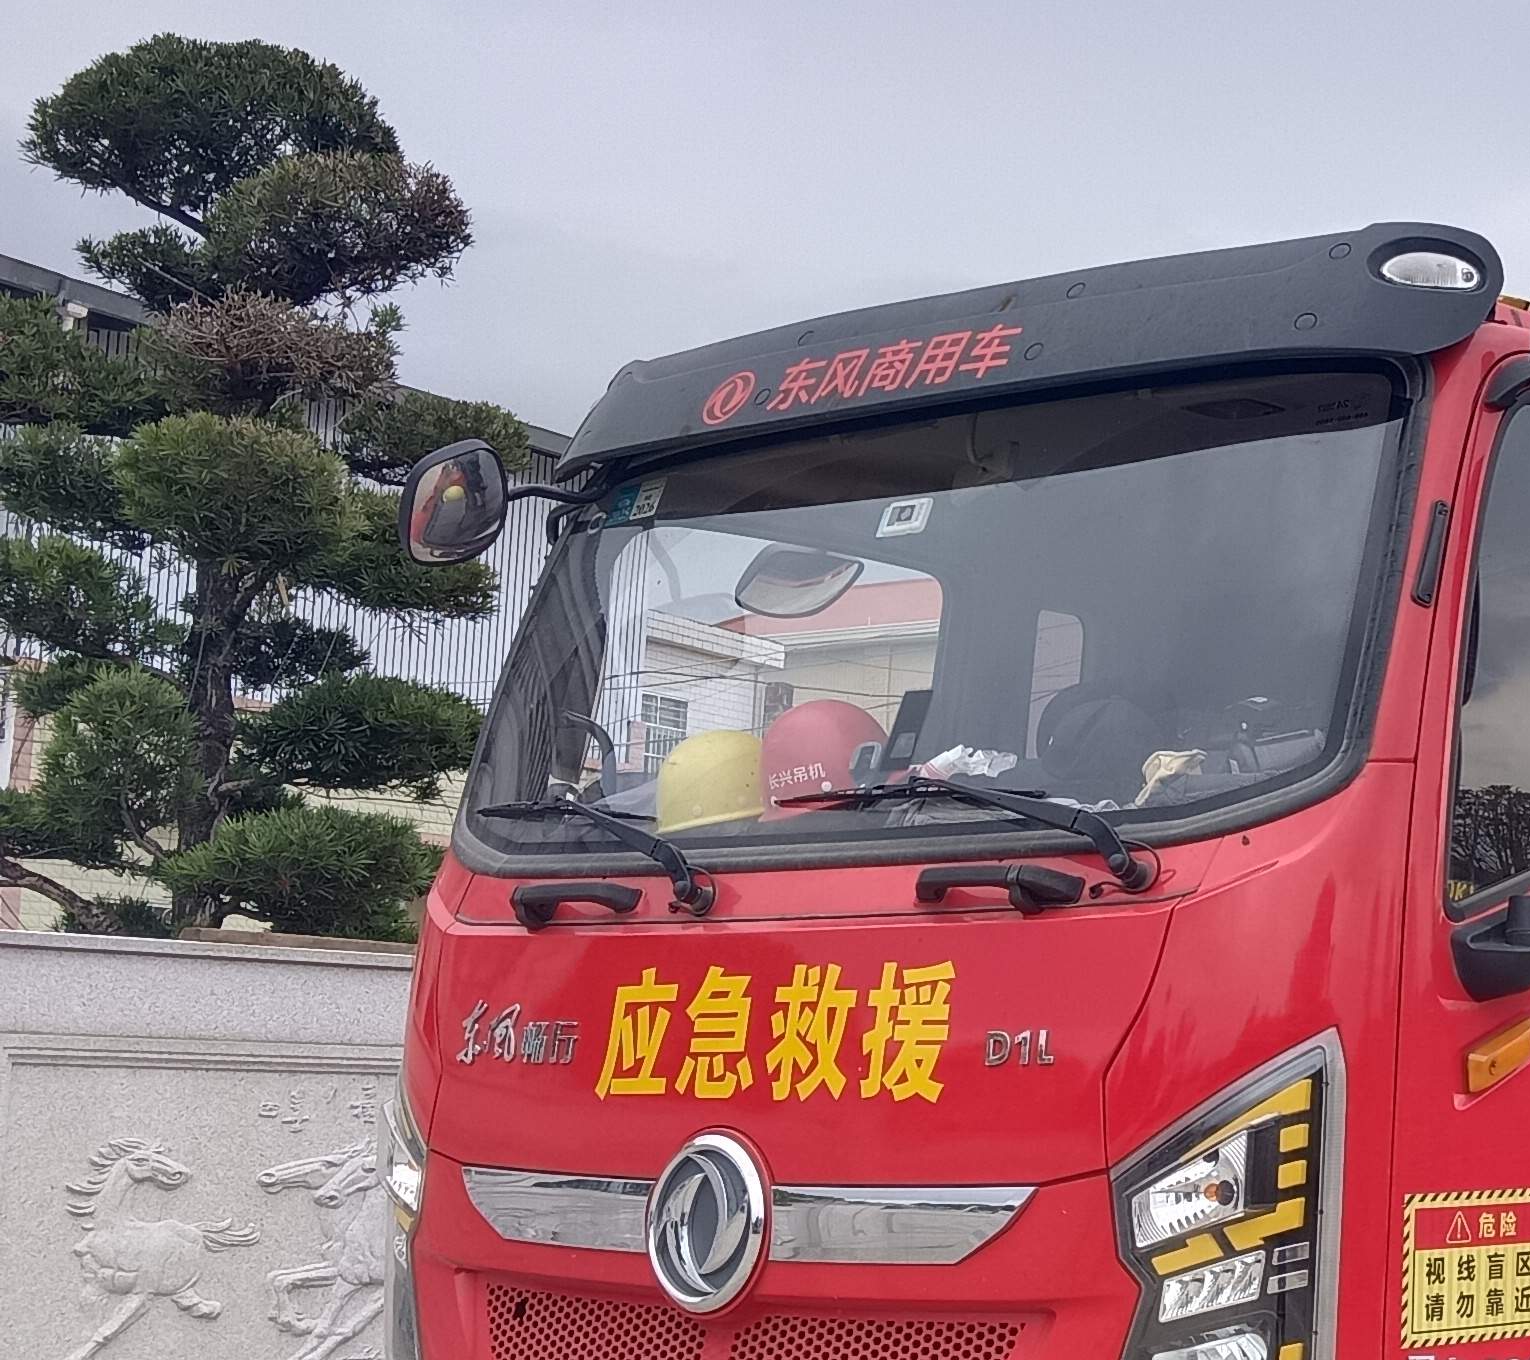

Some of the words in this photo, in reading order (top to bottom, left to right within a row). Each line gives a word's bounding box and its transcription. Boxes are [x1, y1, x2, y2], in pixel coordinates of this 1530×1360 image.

[766, 324, 1023, 411] 东风商用车
[768, 762, 826, 790] 长兴吊机
[595, 960, 956, 1103] 应急救援
[985, 1029, 1054, 1065] D1L
[1478, 1211, 1517, 1239] 危险
